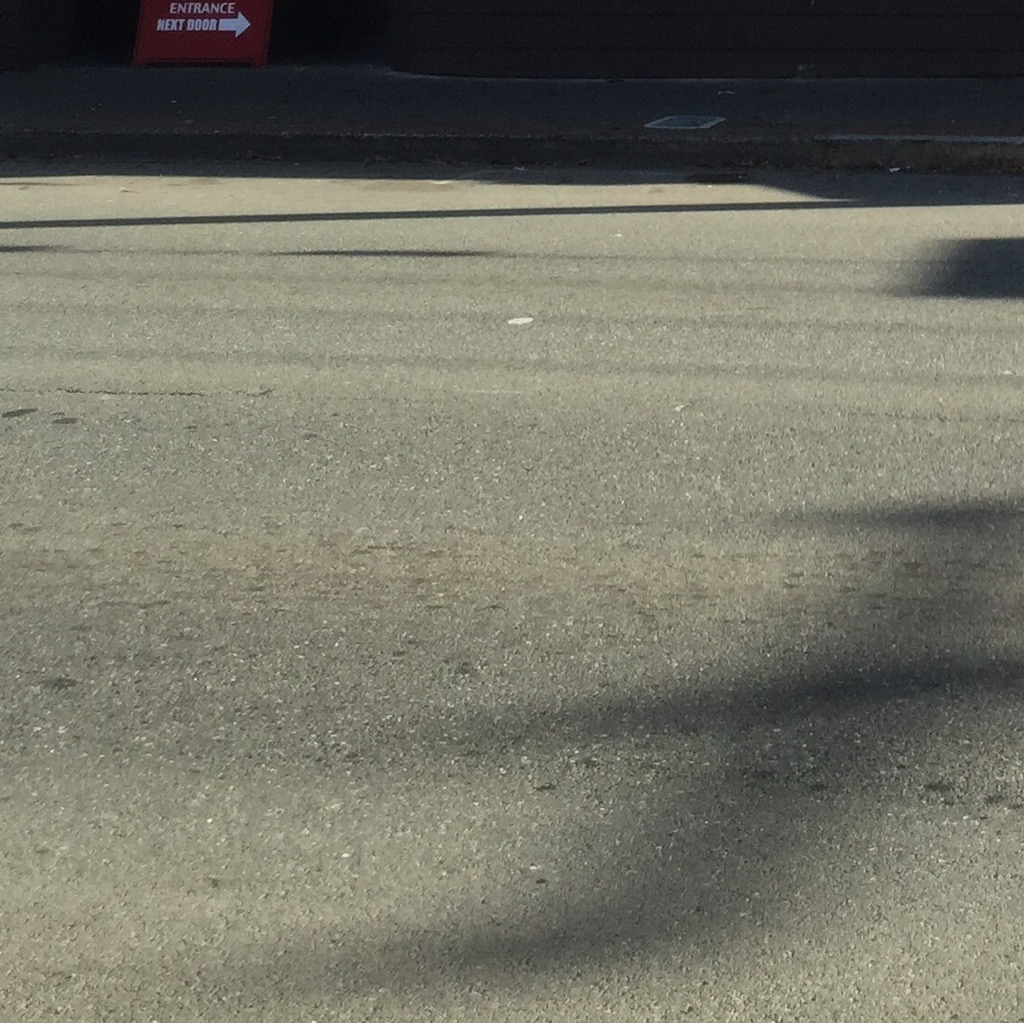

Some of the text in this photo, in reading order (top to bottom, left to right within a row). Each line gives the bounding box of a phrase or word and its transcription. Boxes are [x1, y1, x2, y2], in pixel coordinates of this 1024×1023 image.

[169, 2, 236, 14] ENTRANCE
[156, 18, 218, 31] NEXT DOOR
